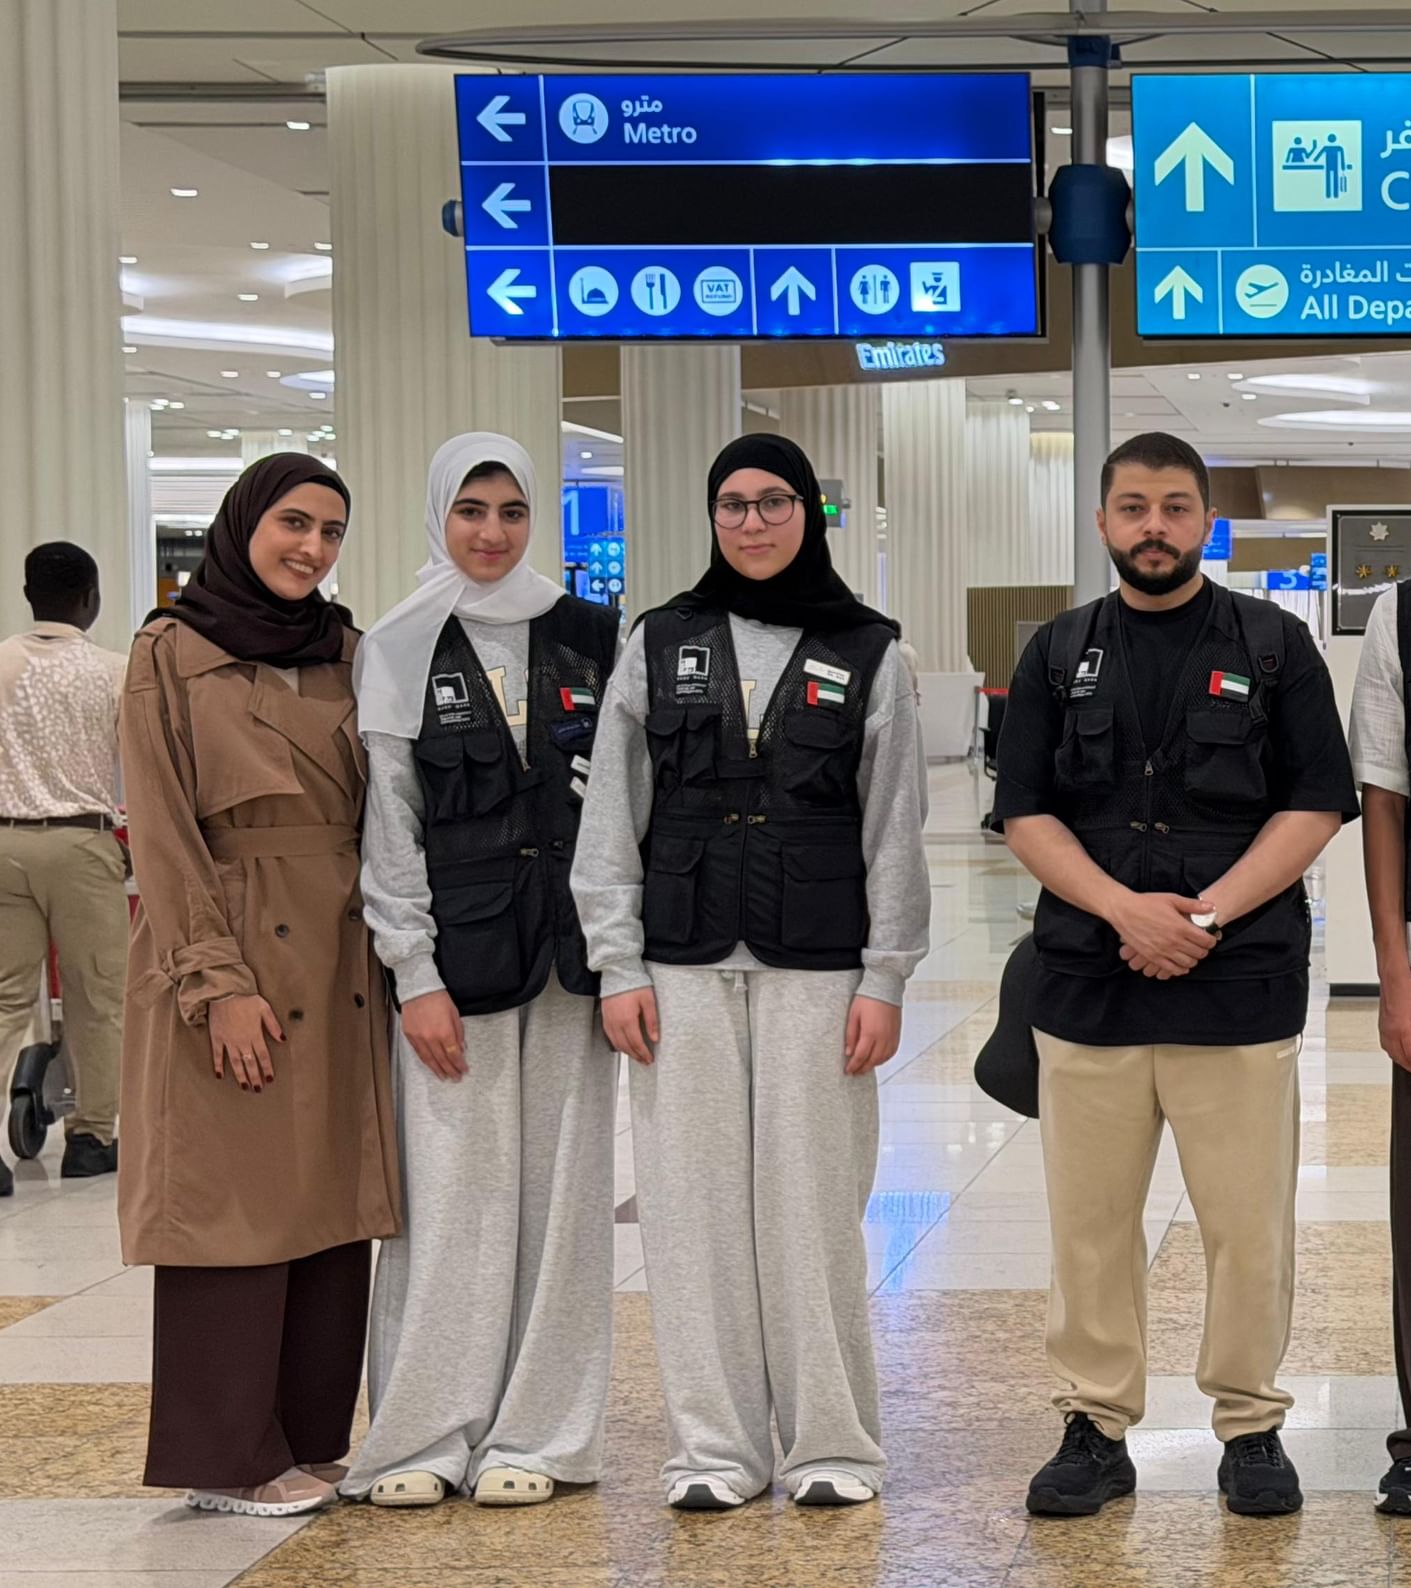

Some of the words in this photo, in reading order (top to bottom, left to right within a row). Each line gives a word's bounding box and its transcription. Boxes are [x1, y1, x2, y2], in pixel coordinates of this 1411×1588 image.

[621, 94, 662, 117] مترو
[624, 123, 697, 143] Metro
[1300, 261, 1388, 288] المغادرة
[706, 283, 730, 293] VAT
[1301, 294, 1337, 319] All
[855, 341, 946, 371] Emirates
